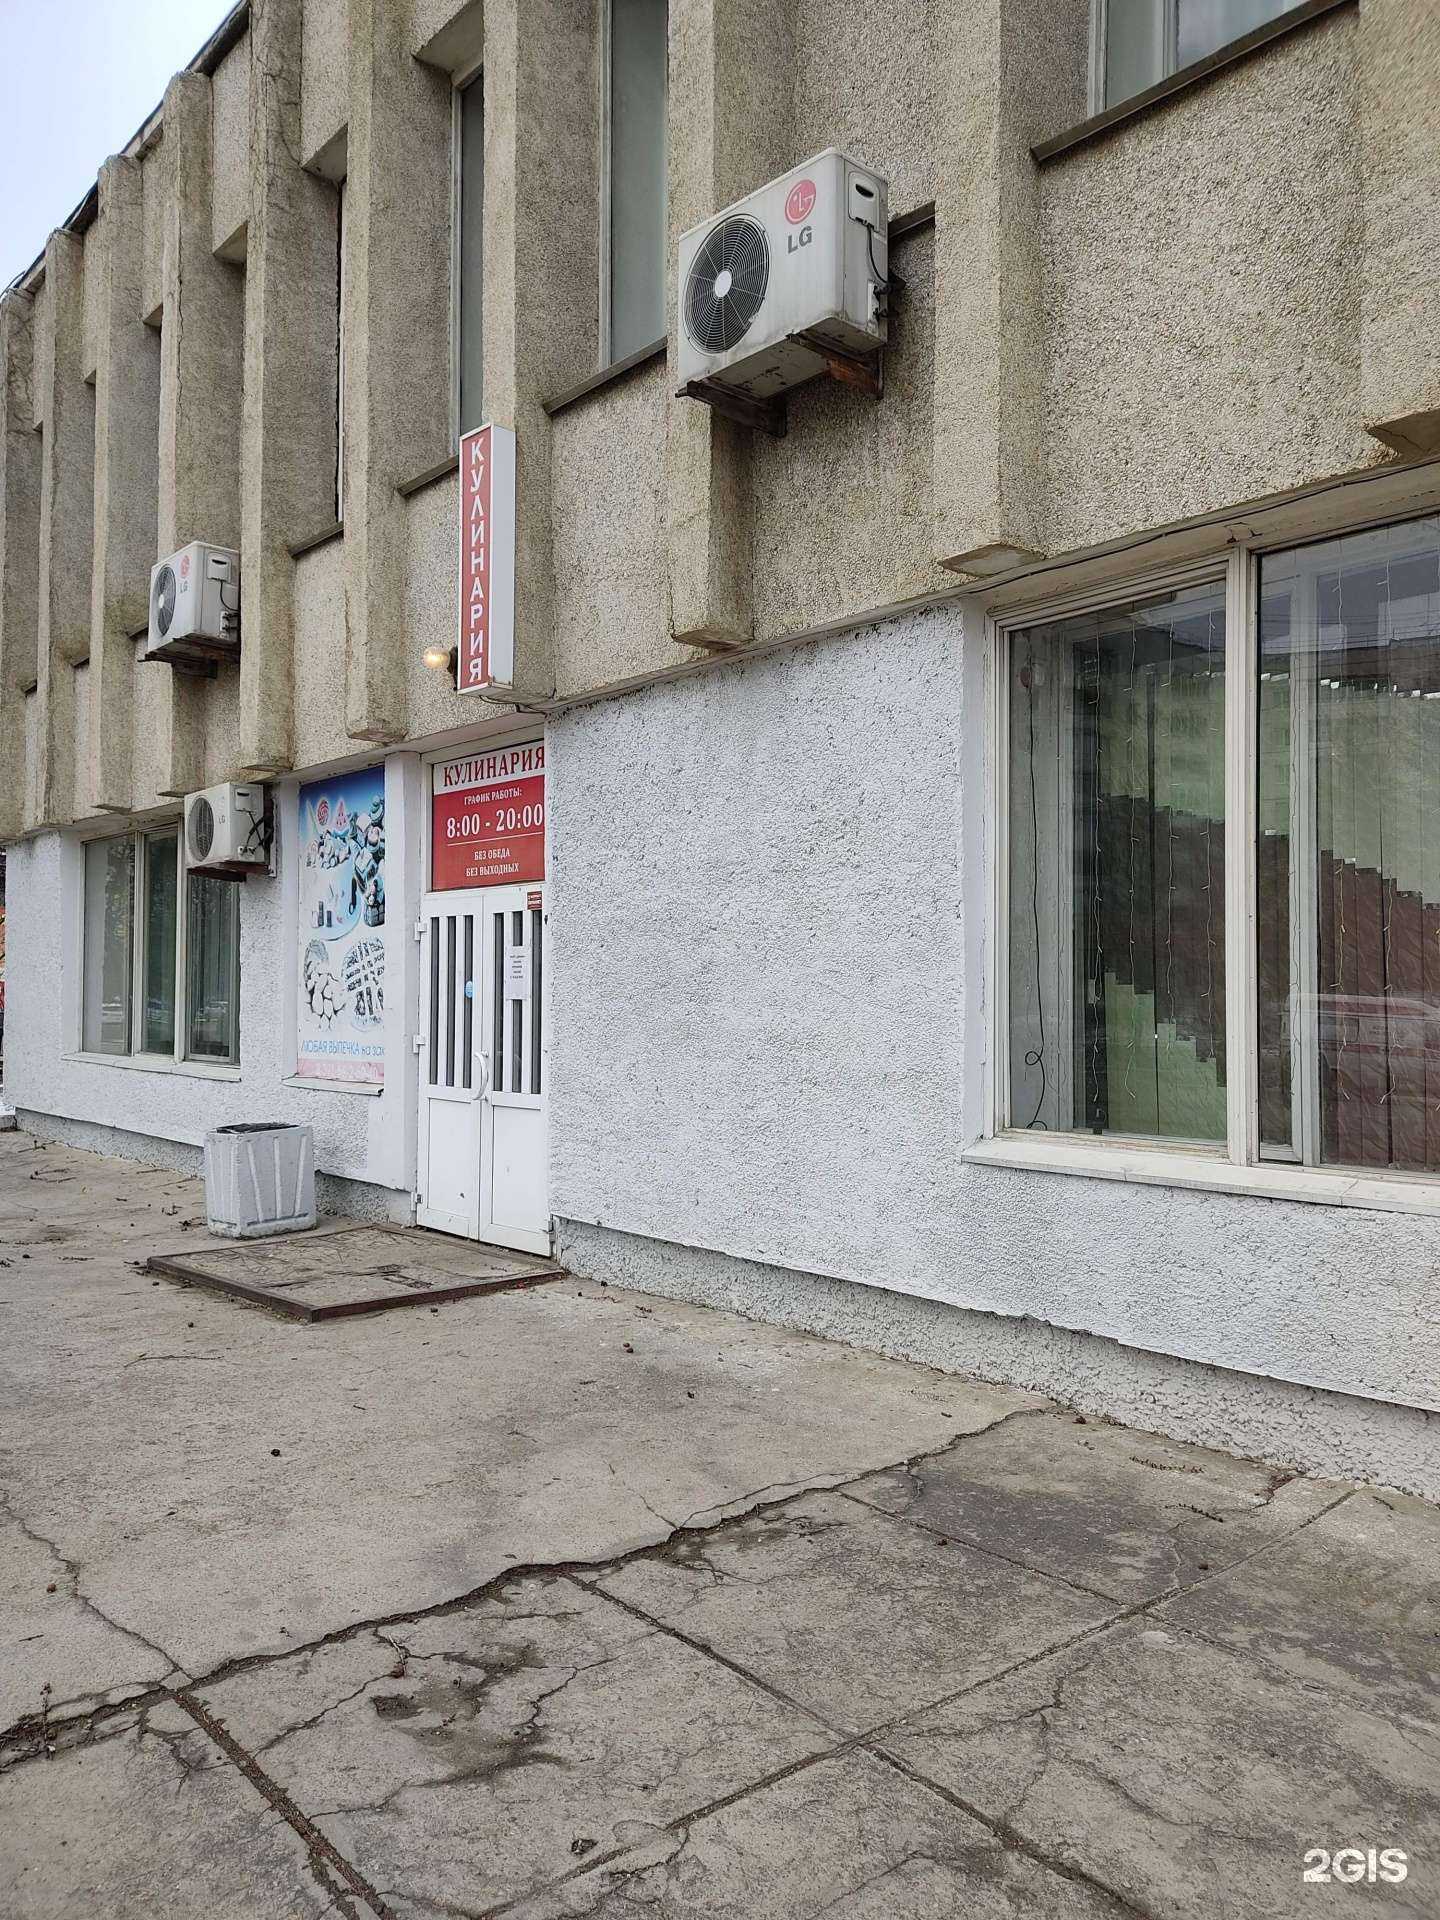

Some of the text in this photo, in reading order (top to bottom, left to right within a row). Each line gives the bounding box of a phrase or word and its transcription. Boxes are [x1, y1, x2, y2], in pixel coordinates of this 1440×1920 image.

[787, 226, 812, 253] LG
[469, 438, 484, 683] КУЛИНАРИЯ
[443, 745, 545, 787] КУЛИНАРИЯ
[464, 787, 522, 805] ГРАФИК РАБОТЫ:
[447, 813, 480, 838] 8:00
[496, 803, 543, 832] 20:00
[474, 847, 511, 861] БЕЗ ОБЕДА
[466, 863, 520, 877] БЕЗ ВЫХОДНЫХ
